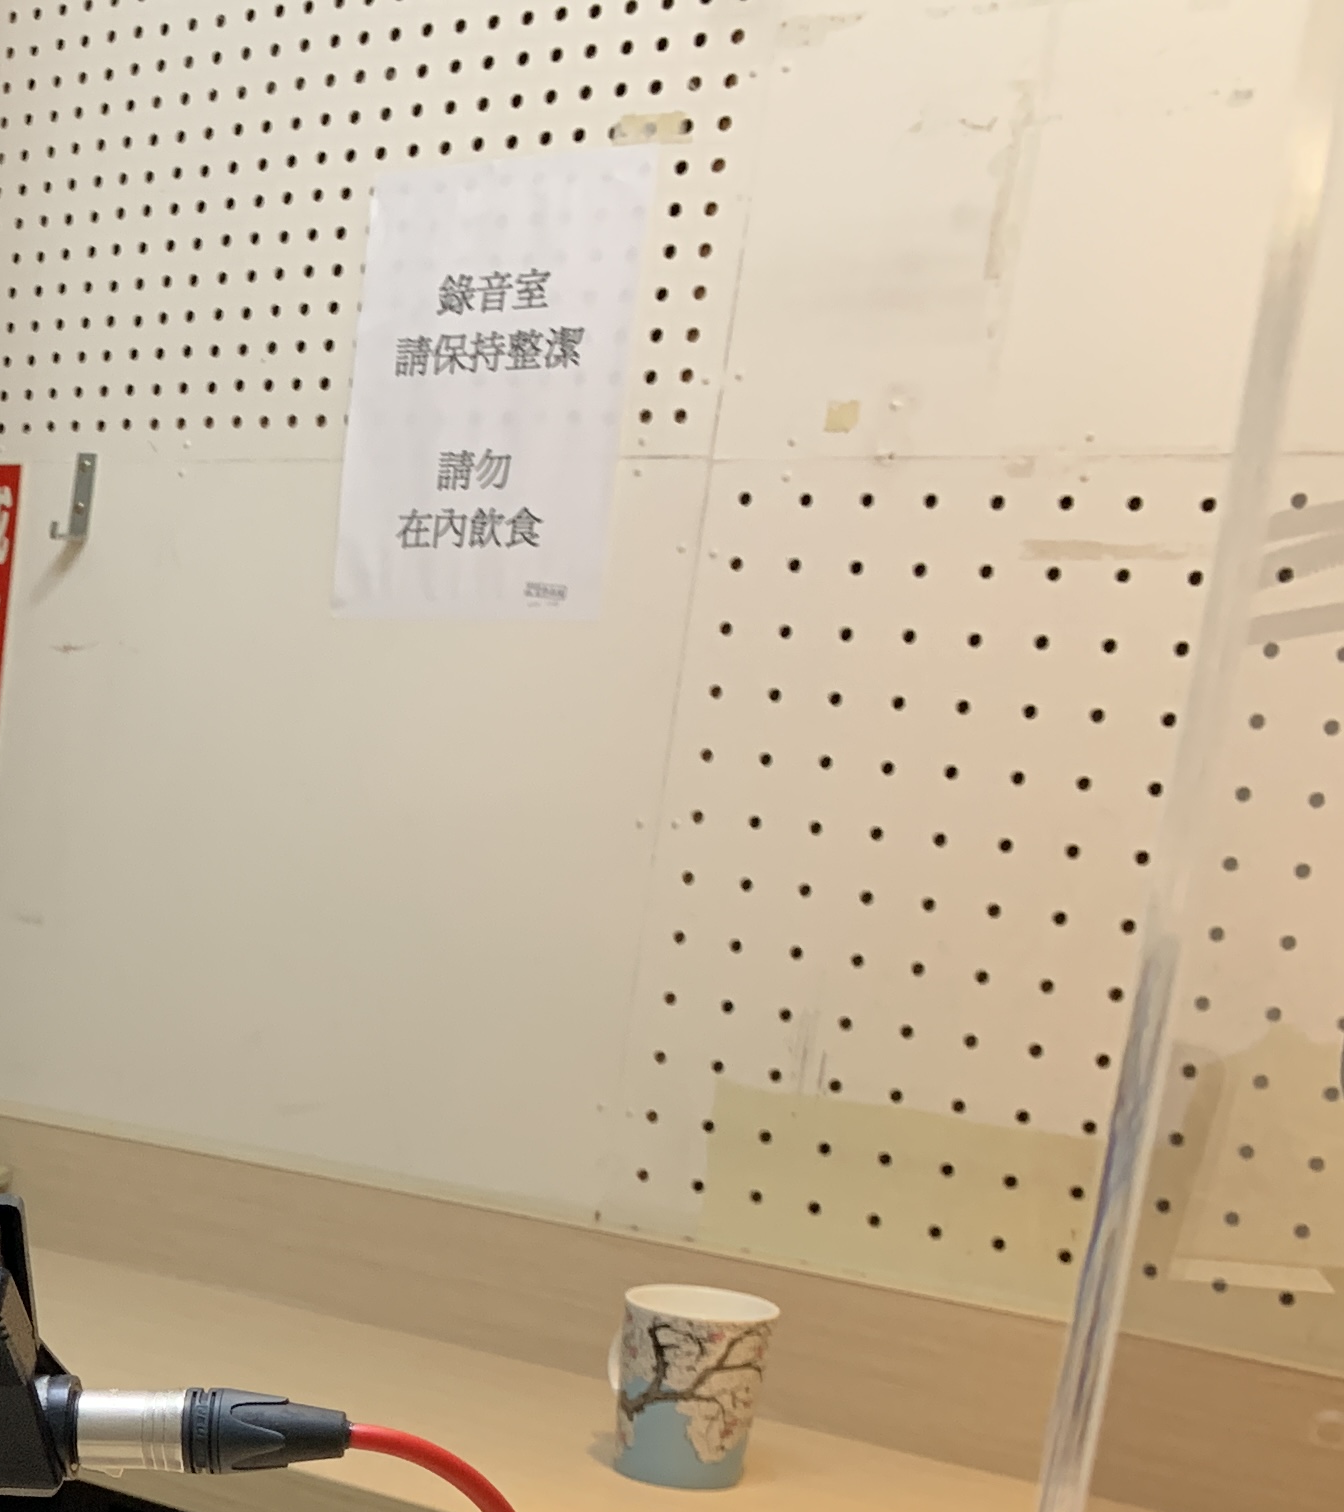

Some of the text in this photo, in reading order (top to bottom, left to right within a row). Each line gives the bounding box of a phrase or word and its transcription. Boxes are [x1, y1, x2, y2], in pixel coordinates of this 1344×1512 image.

[436, 268, 551, 316] 錄音室
[394, 325, 585, 378] 請保持整潔
[436, 448, 512, 492] 請勿
[395, 506, 543, 550] 在內飲食
